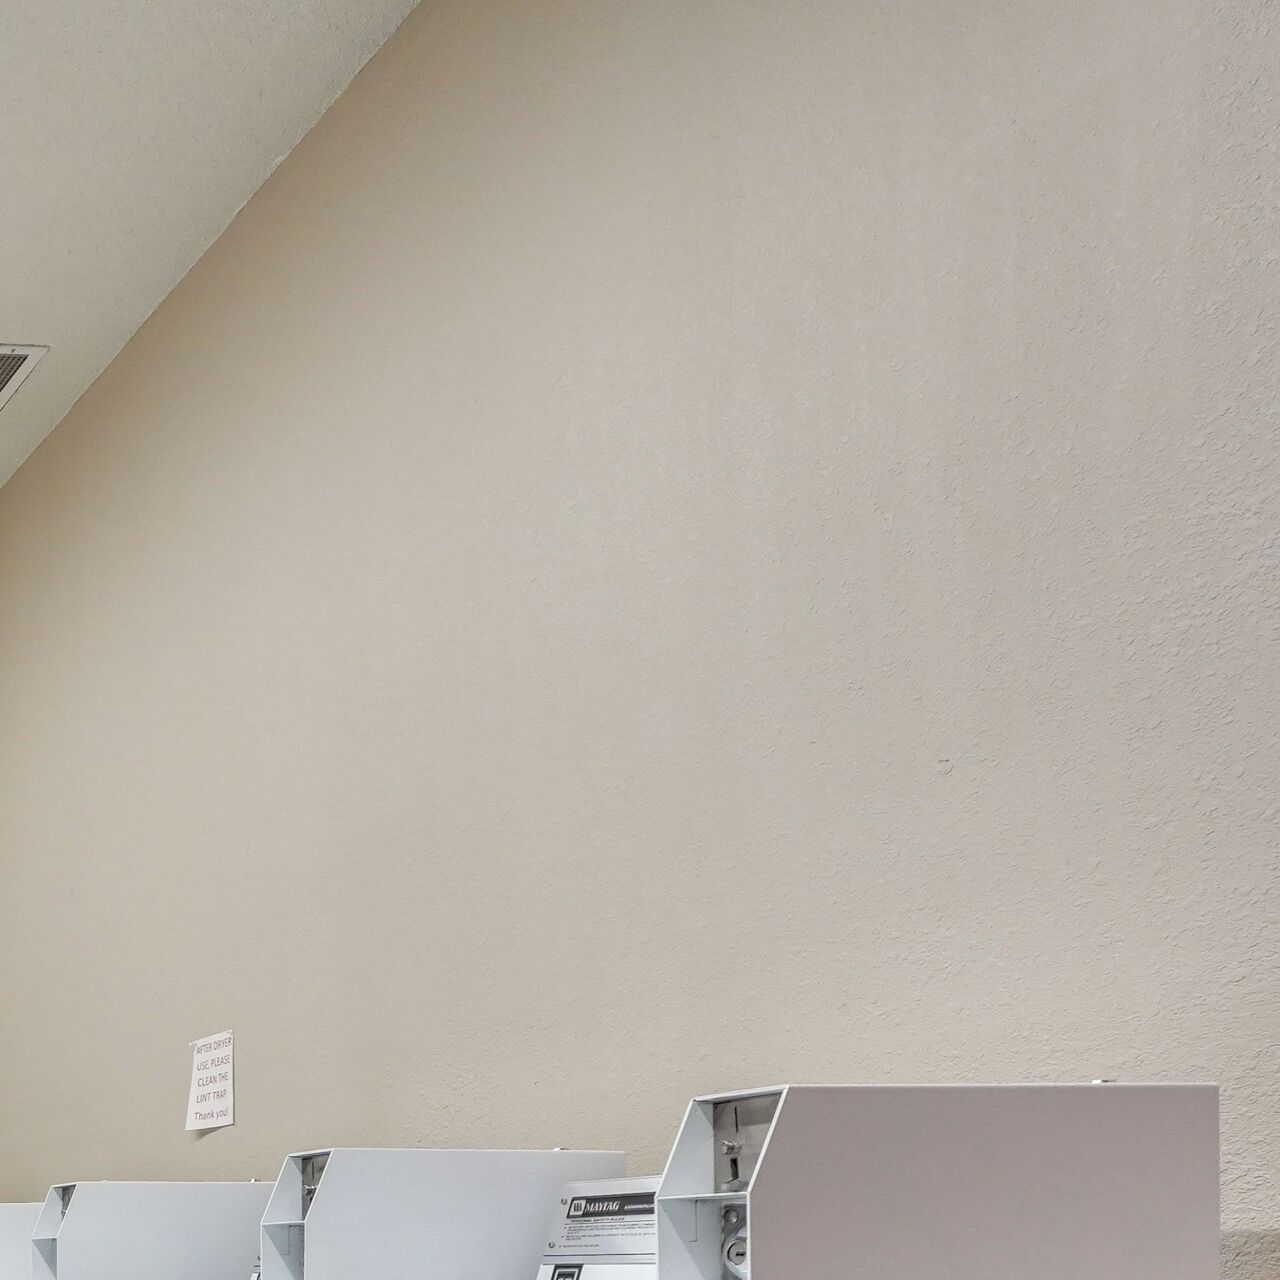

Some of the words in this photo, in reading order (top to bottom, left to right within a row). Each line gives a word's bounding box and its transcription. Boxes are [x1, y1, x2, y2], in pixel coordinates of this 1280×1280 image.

[196, 1043, 213, 1055] AFTER
[213, 1037, 232, 1050] DRYER
[210, 1054, 230, 1068] PLEASE
[198, 1075, 217, 1087] CLEAN
[218, 1072, 229, 1081] THE
[196, 1093, 211, 1103] LINT
[194, 1110, 215, 1120] Thank
[585, 1201, 620, 1213] MAYTAG
